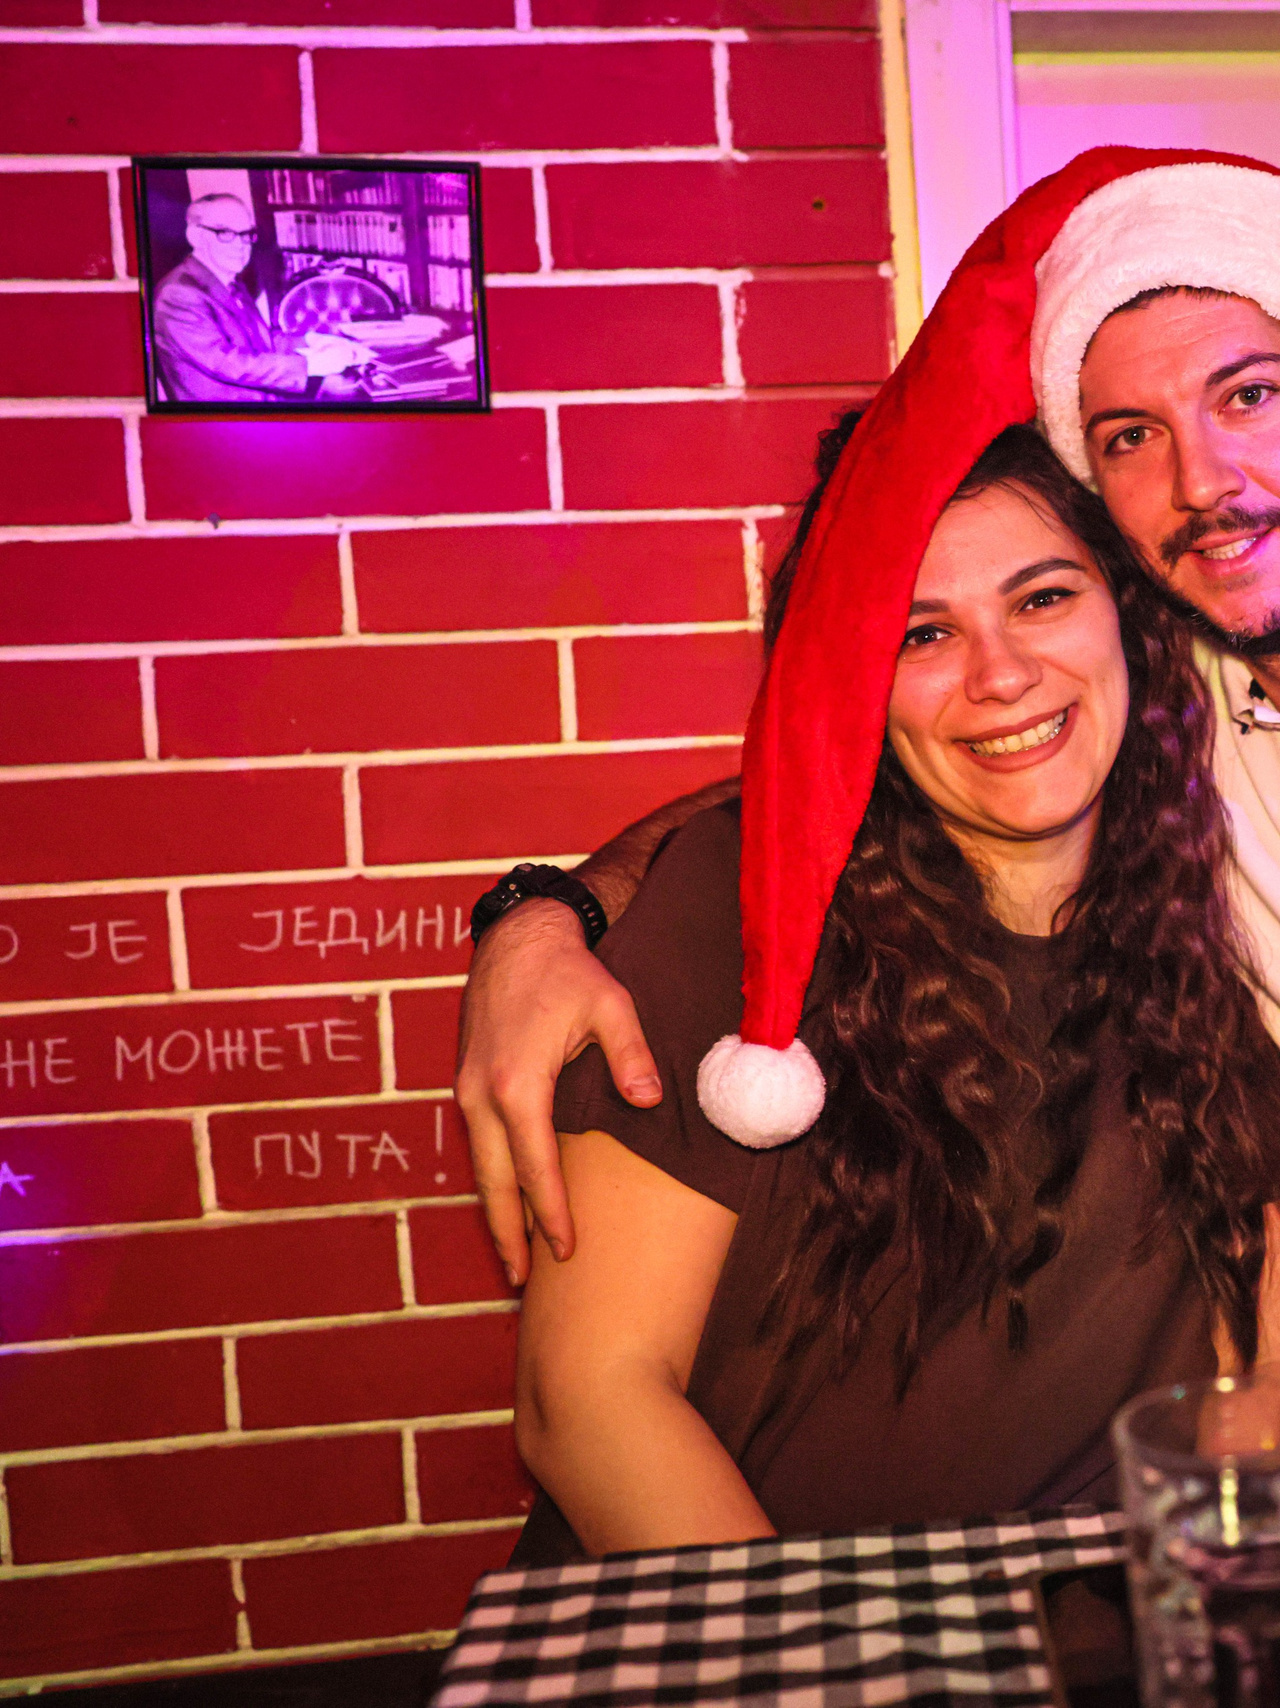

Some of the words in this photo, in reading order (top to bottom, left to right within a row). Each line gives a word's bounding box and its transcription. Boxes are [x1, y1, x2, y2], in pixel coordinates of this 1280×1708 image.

[64, 919, 148, 964] ЈЕ
[0, 1037, 77, 1088] НЕ
[114, 1018, 364, 1082] МОЖЕТЕ
